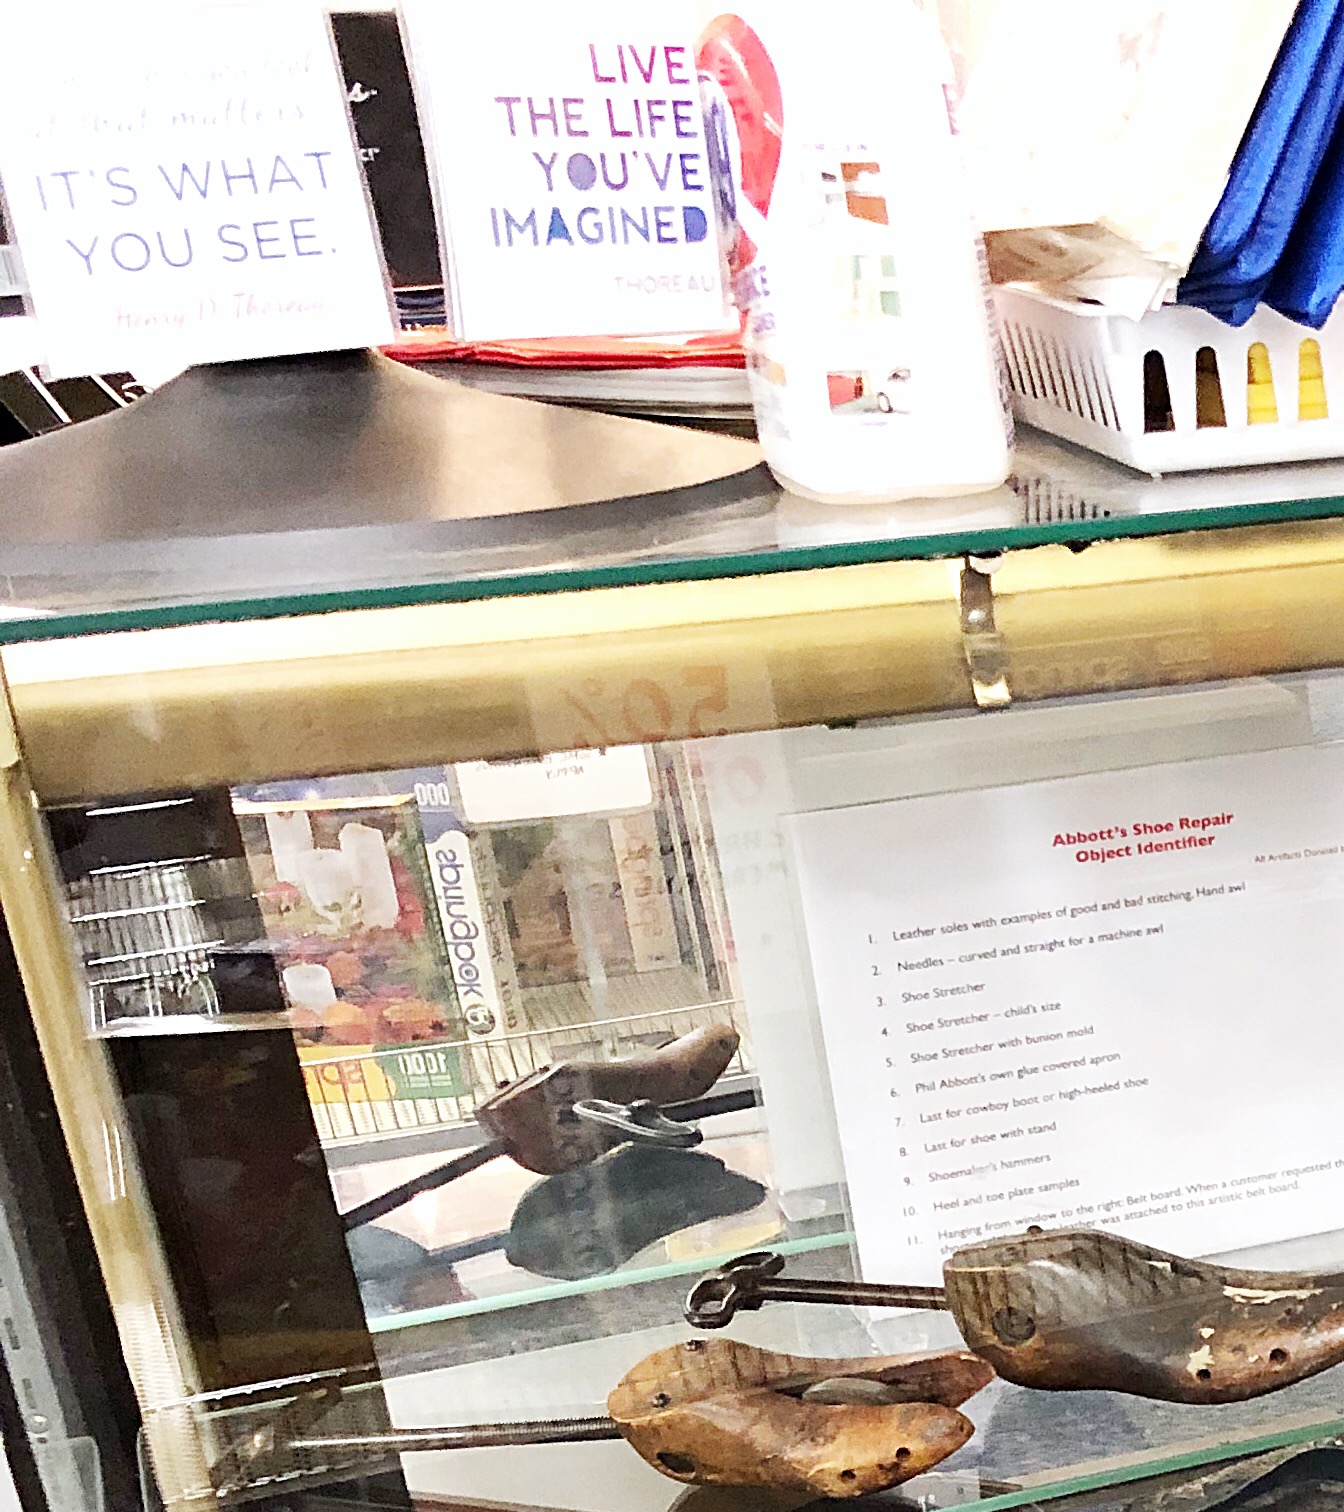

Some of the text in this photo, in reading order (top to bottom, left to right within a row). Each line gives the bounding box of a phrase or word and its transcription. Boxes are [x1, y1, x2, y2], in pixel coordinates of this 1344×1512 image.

[589, 44, 690, 85] LIVE
[495, 97, 698, 138] THE LIFE
[36, 152, 332, 211] IT'S WHAT
[532, 151, 704, 192] YOU'VE
[66, 218, 337, 275] YOU SEE.
[490, 205, 708, 247] IMAGINED
[614, 275, 717, 294] THOREAU
[1052, 811, 1235, 847] Abbott's Shoe Repair
[1075, 834, 1217, 863] Object Identifier
[868, 934, 877, 944] 1.
[892, 927, 936, 941] Leather
[940, 922, 969, 934] soles
[972, 917, 997, 929] with
[1001, 911, 1052, 925] examples
[1056, 905, 1067, 917] of
[1070, 901, 1098, 918] good
[1101, 898, 1121, 911] and
[1123, 895, 1143, 908] bad
[1196, 884, 1225, 897] Hand
[1228, 881, 1245, 893] awl
[871, 924, 1164, 976] 2. Needles curved and straight for machine awl
[876, 984, 986, 1007] 3. Shoe Stretcher
[881, 1027, 891, 1037] 4.
[906, 1022, 934, 1033] Shoe
[937, 1013, 990, 1028] Stretcher
[1041, 1002, 1061, 1012] size
[886, 1025, 1094, 1067] 5. Shoe Stretcher with bunion mold
[890, 1053, 1121, 1097] 6. Phil Abbott's own glue covered apron
[895, 1117, 904, 1127] 7.
[920, 1112, 943, 1123] Last
[945, 1109, 962, 1118] for
[966, 1102, 1009, 1115] cowboy
[1012, 1096, 1040, 1107] boot
[1058, 1080, 1120, 1101] high-heeled
[1123, 1078, 1149, 1088] shoe
[899, 1121, 1057, 1157] 8. Last for shoe with stand
[903, 1177, 913, 1186] 9.
[1000, 1155, 1051, 1169] hammers
[903, 1206, 919, 1217] 10.
[908, 1236, 923, 1246] 11.
